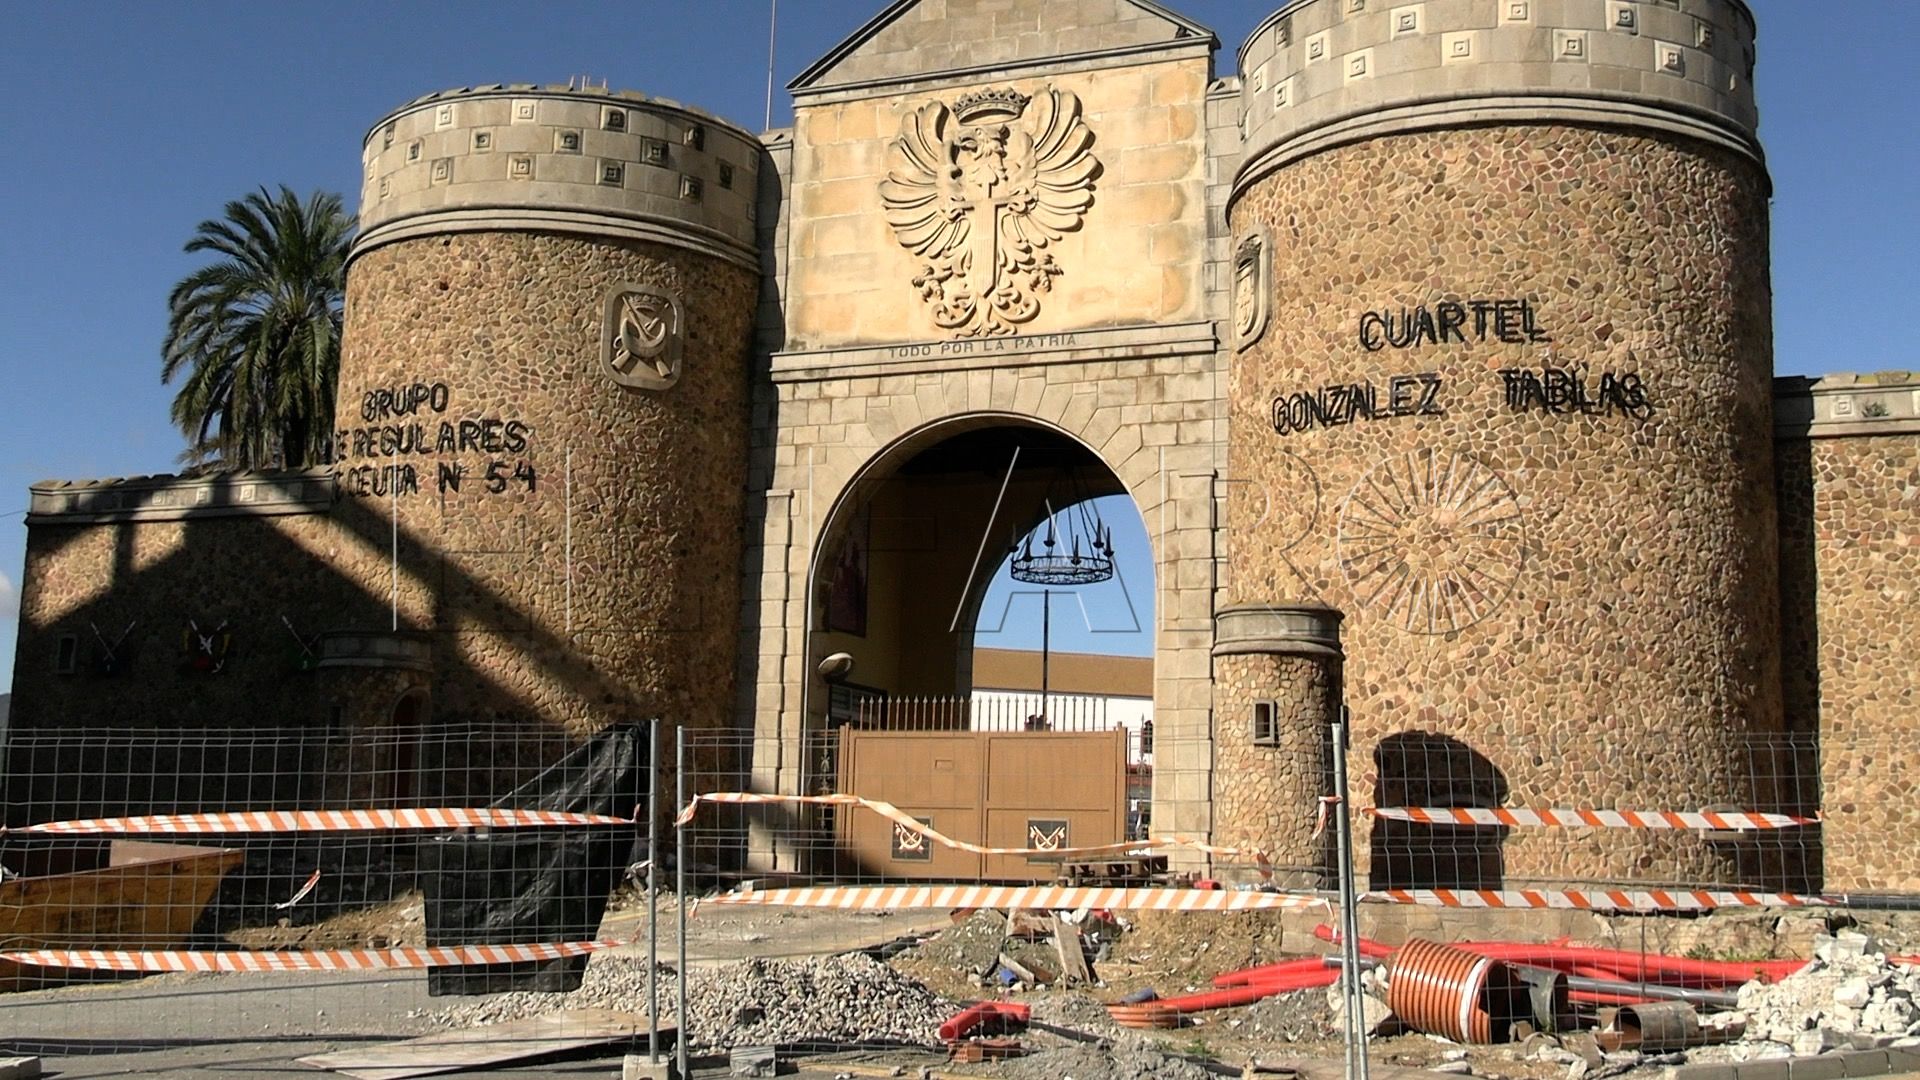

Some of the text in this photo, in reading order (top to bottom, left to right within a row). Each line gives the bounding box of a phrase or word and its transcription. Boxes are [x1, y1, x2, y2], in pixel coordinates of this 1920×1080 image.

[1359, 298, 1552, 351] CUARTEL
[888, 334, 1077, 359] TODO POR LA PATRIA
[361, 382, 449, 422] GRUPO
[1272, 367, 1656, 436] GONZALEZ TABLAS
[352, 419, 530, 459] REGULARES
[348, 463, 418, 497] CEUTA
